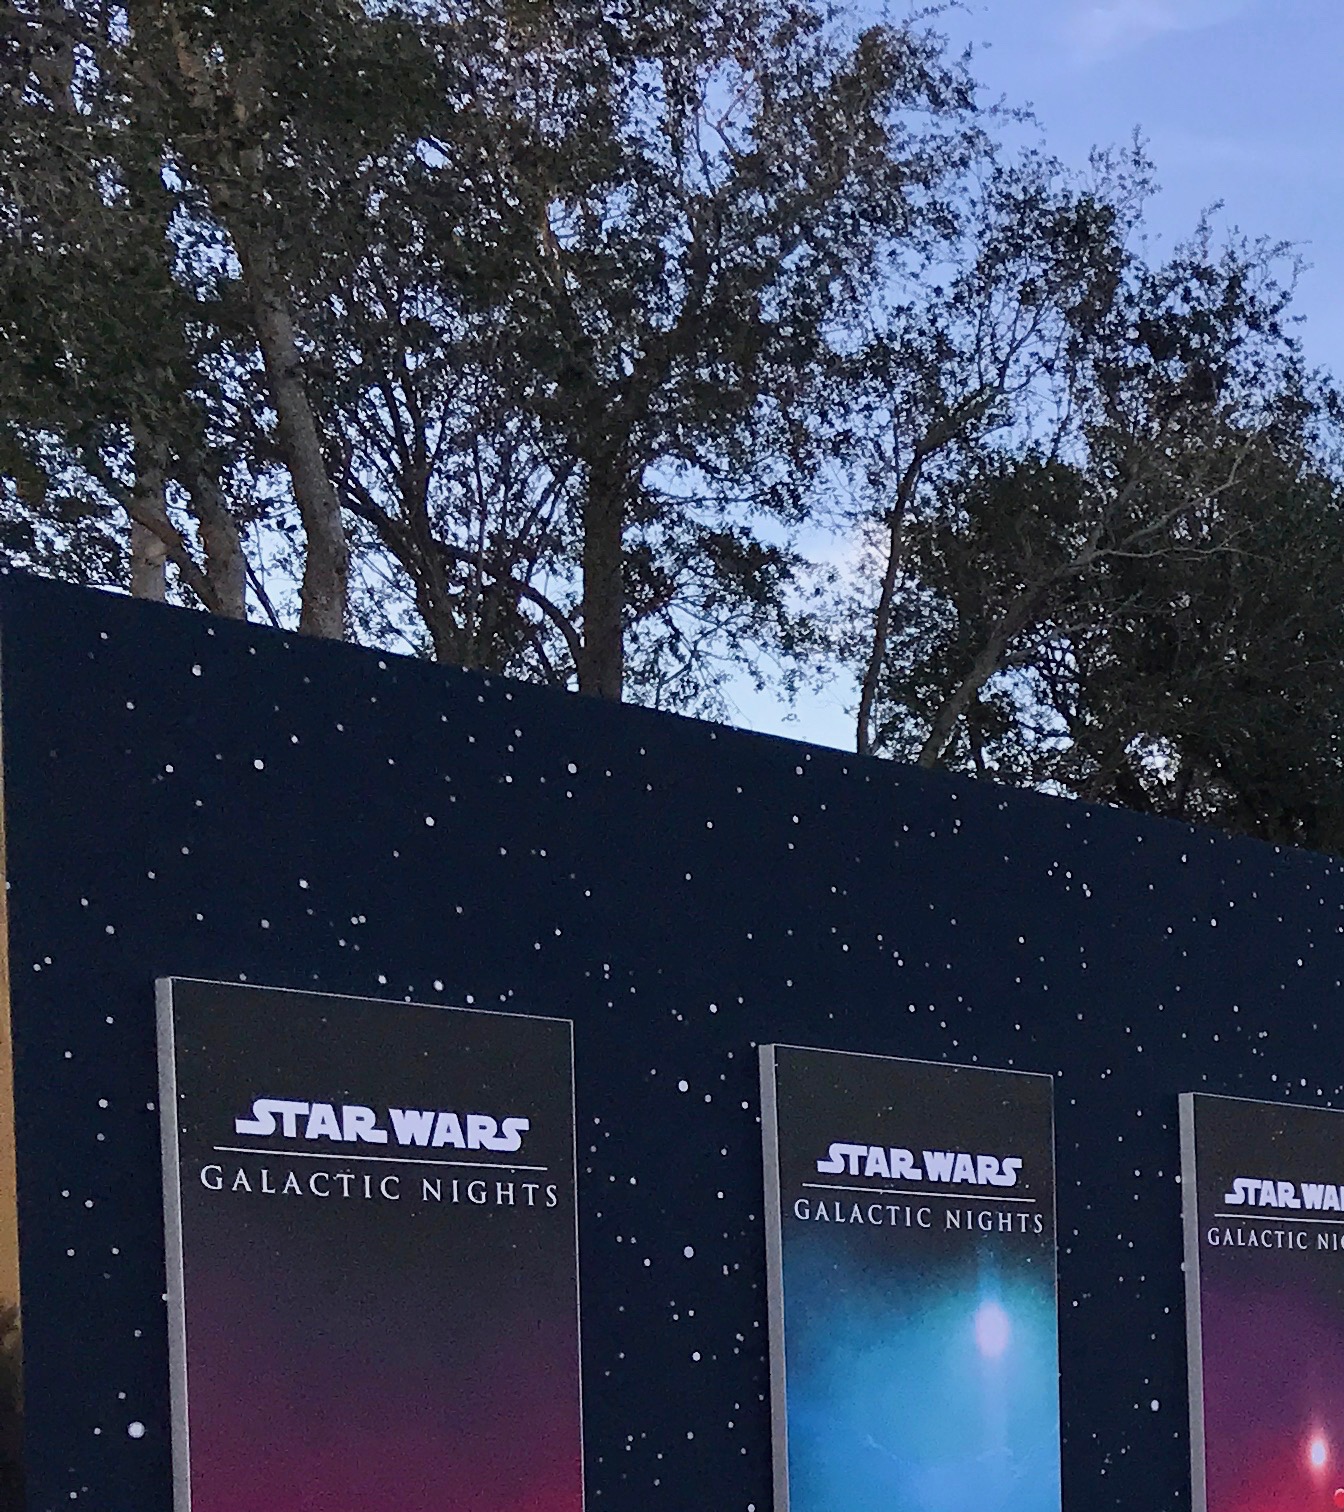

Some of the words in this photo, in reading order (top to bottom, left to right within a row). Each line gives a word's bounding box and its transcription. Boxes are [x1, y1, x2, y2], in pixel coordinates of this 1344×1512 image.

[235, 1099, 388, 1144] STAR
[388, 1108, 530, 1152] WARS
[817, 1142, 922, 1181] STAR
[923, 1150, 1022, 1187] WARS
[201, 1165, 400, 1200] GALACTIC
[422, 1178, 558, 1208] NIGHTS
[1224, 1178, 1301, 1209] STAR
[794, 1199, 932, 1228] GALACTIC
[946, 1209, 1044, 1233] NIGHTS
[1207, 1227, 1308, 1250] GALACTIC
